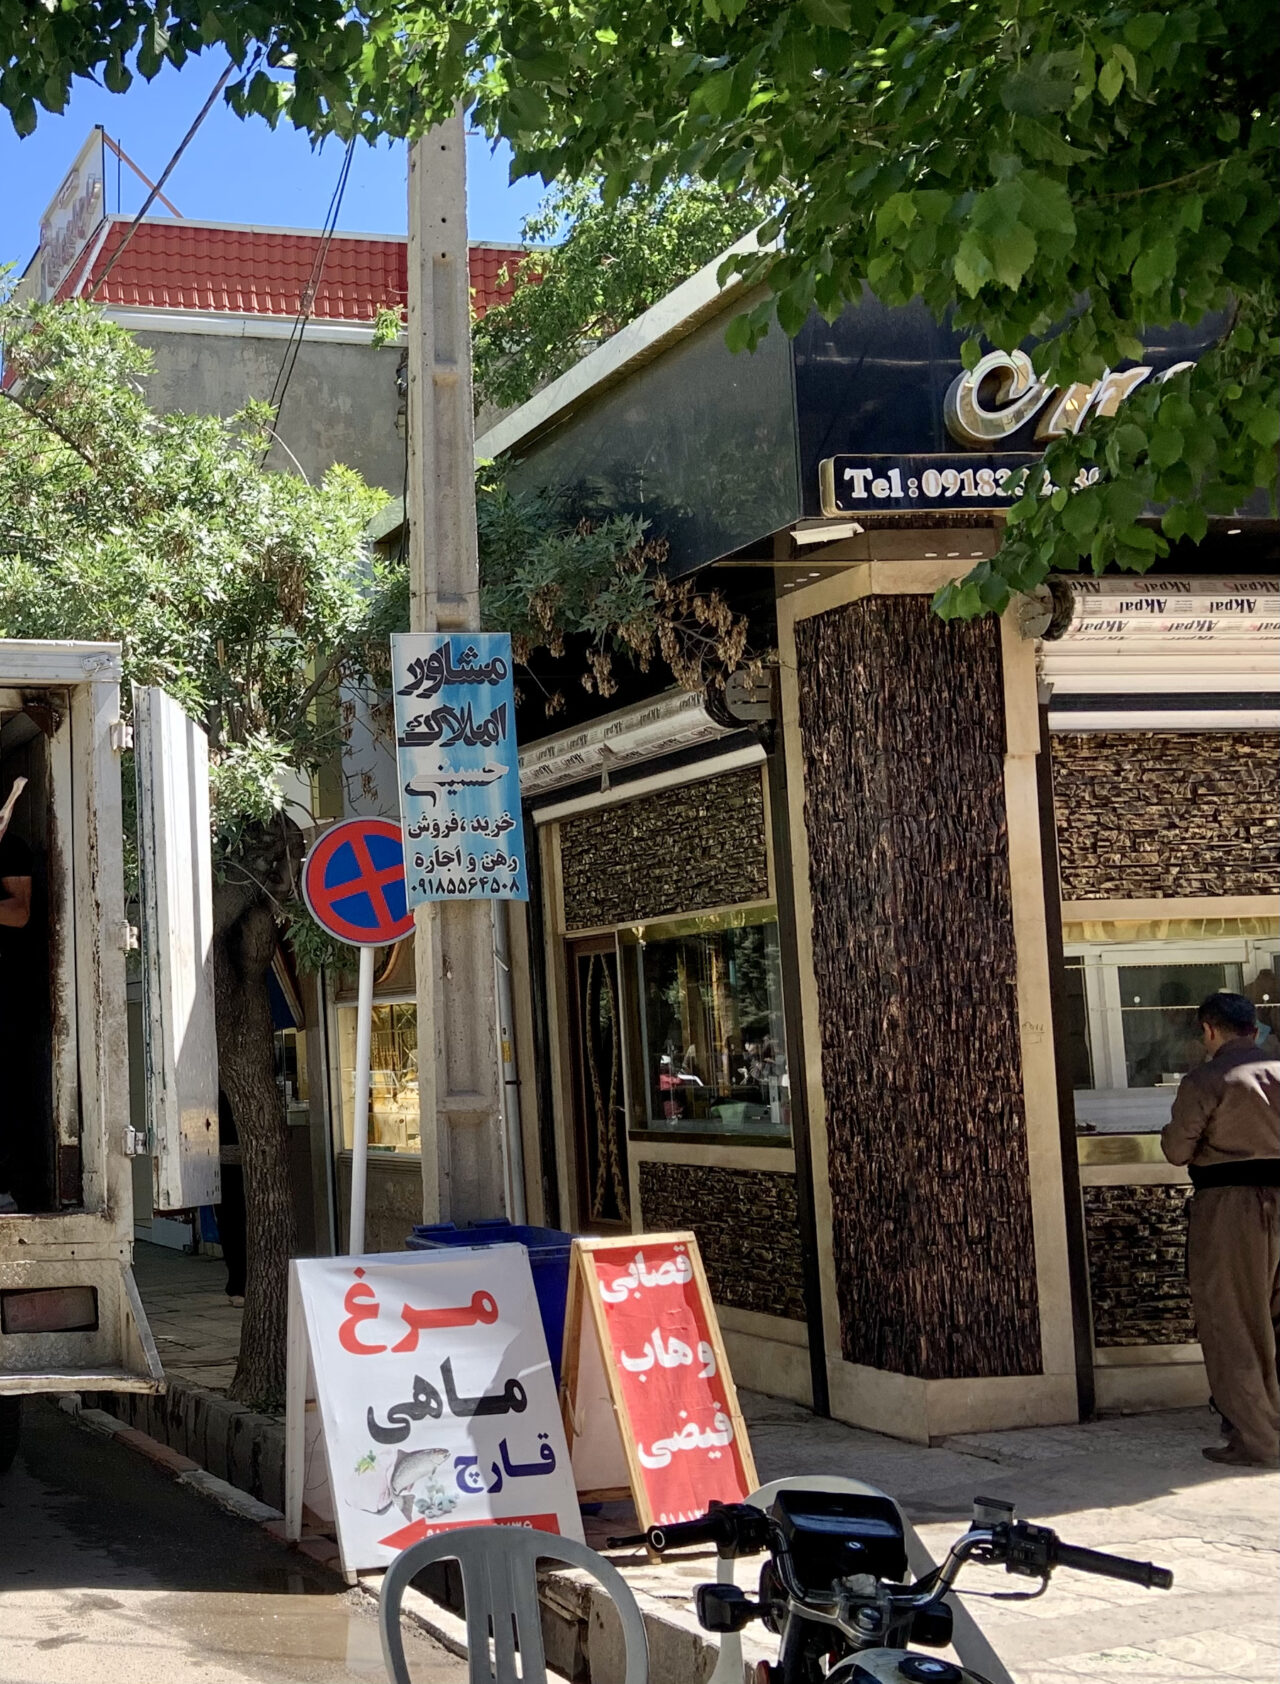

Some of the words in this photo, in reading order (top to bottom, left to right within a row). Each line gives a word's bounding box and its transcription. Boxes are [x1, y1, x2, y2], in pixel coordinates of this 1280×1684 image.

[398, 640, 508, 698] مشاور
[398, 701, 507, 747] املاک
[405, 760, 510, 806] حسینی
[470, 811, 516, 838] خرید
[414, 846, 462, 874] اجاره
[466, 853, 477, 872] و
[481, 850, 518, 872] رهن
[598, 1244, 694, 1304] قصابی
[338, 1266, 499, 1356] مرغ
[621, 1326, 717, 1383] وهاب
[366, 1356, 528, 1445] ماهی
[453, 1432, 557, 1494] قارچ
[637, 1401, 734, 1470] فیضی
